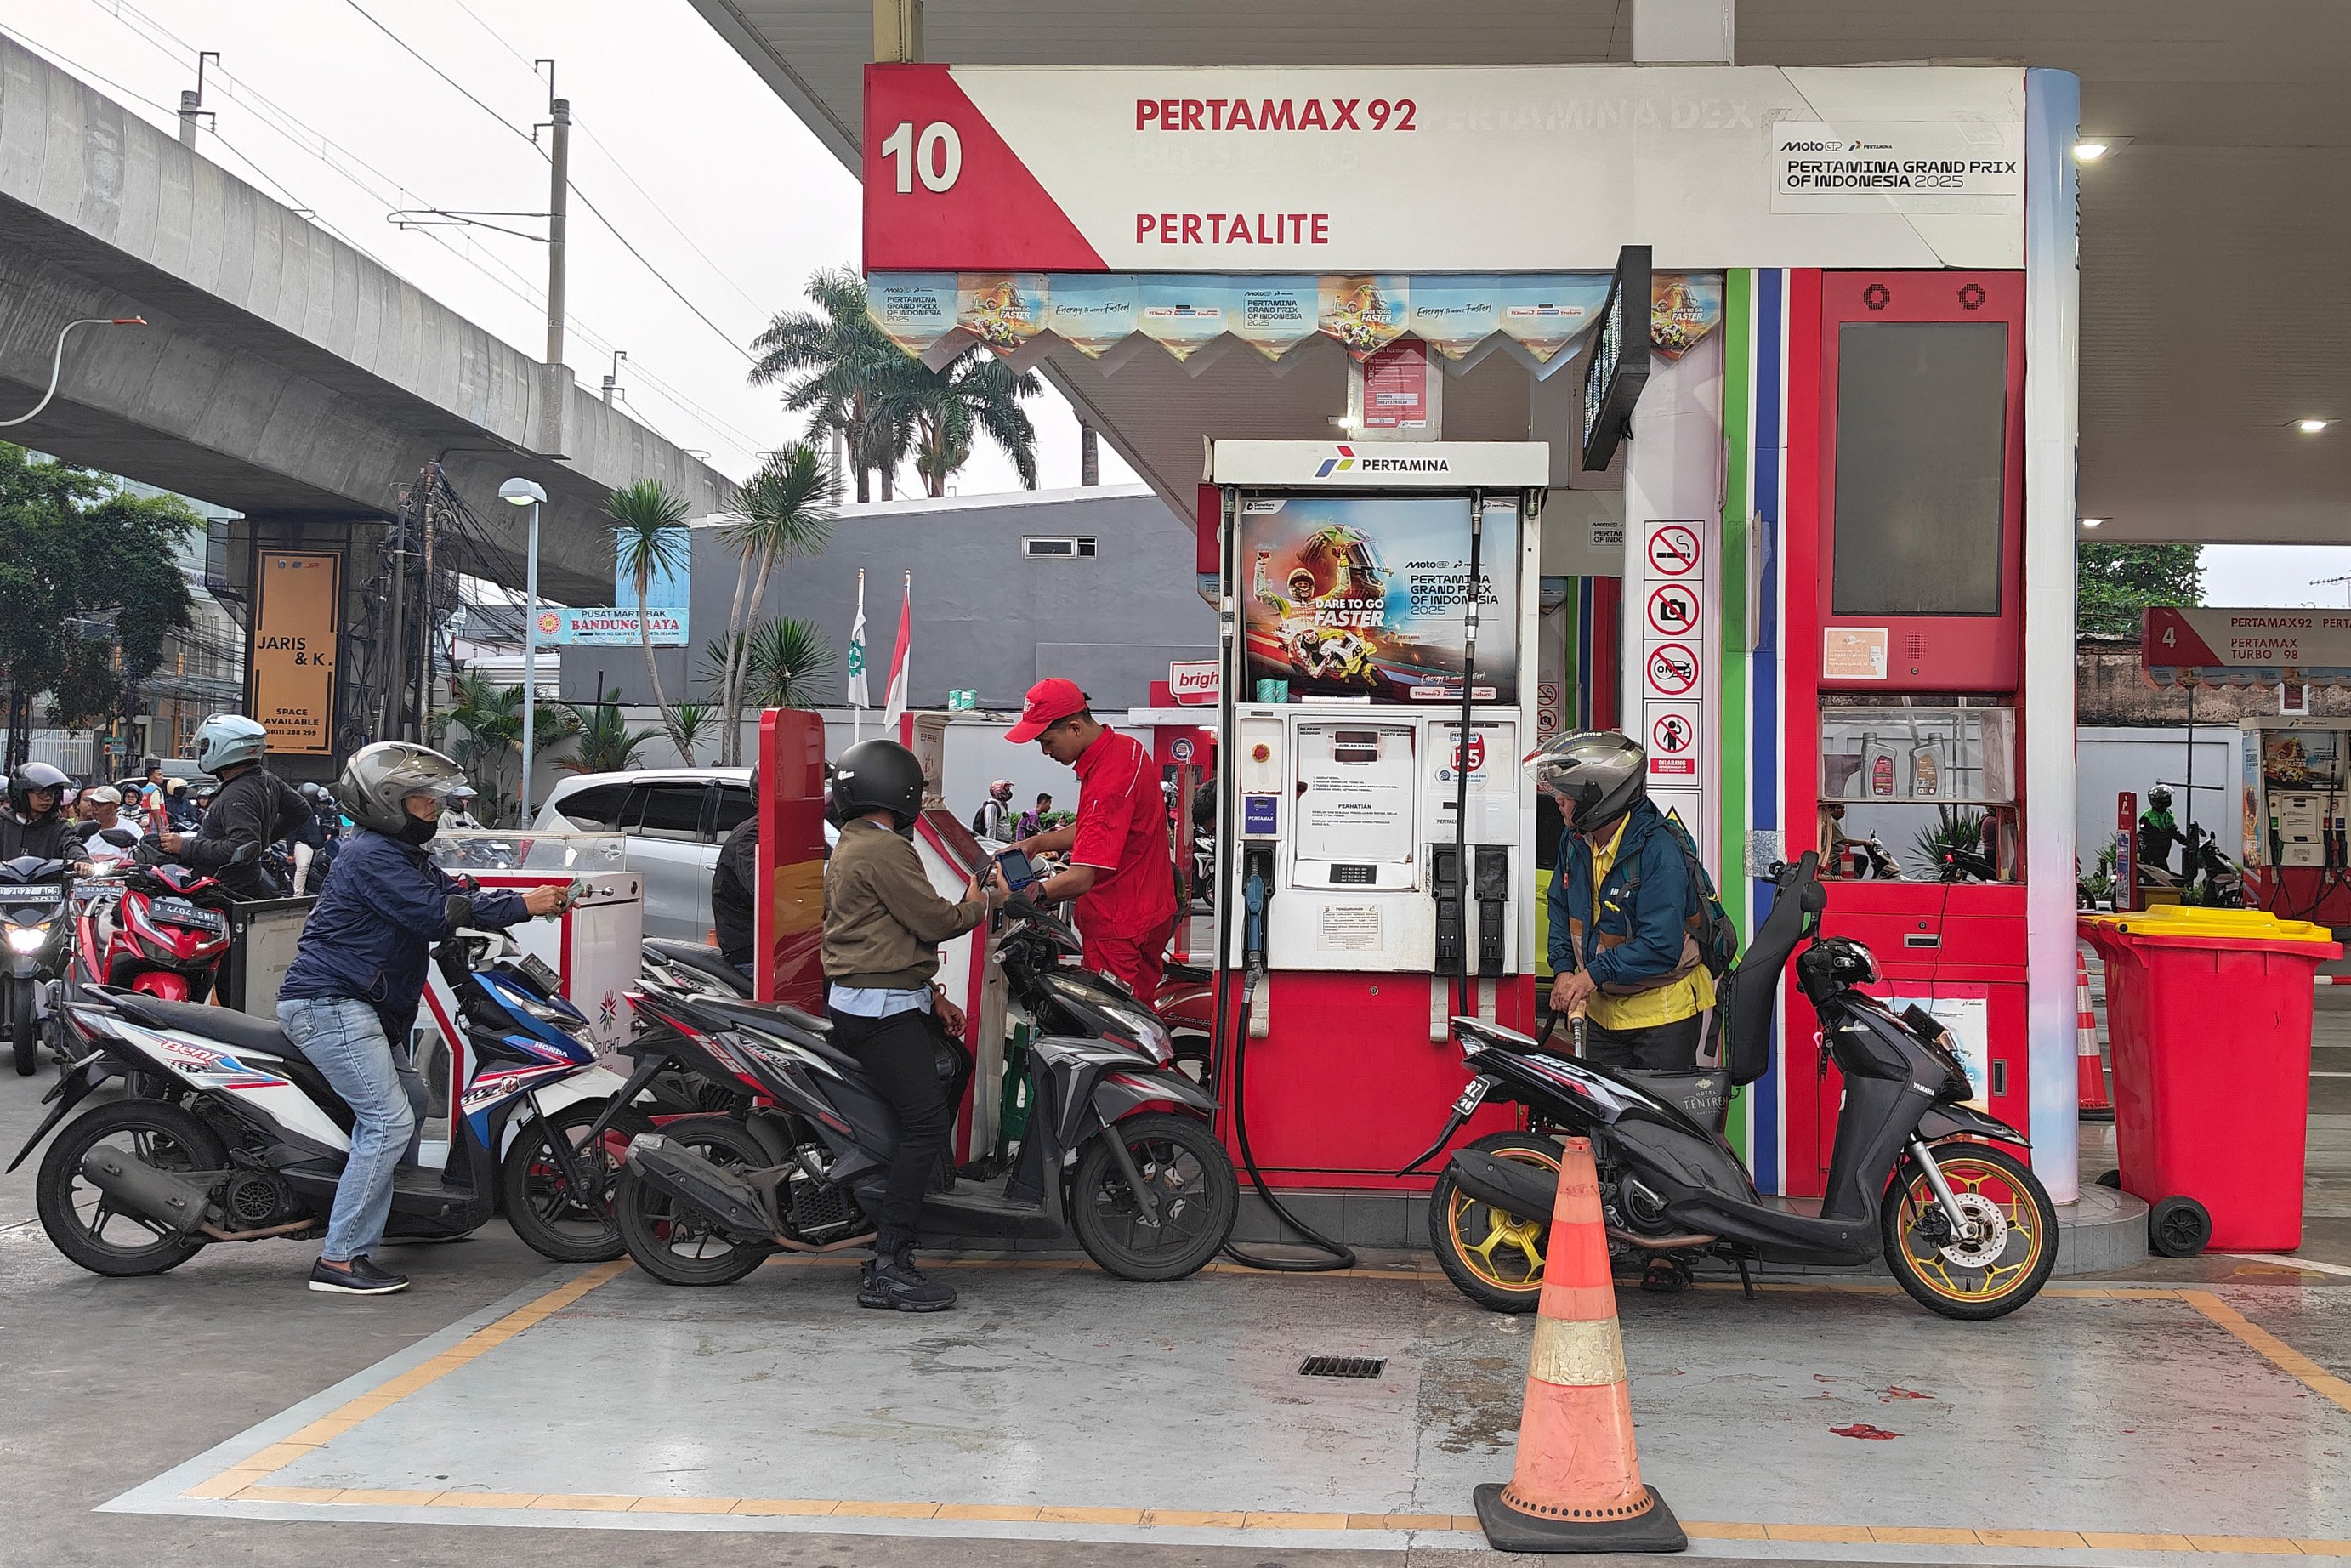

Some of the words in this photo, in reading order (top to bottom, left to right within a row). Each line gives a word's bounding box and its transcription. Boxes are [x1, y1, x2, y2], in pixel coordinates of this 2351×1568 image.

[1136, 99, 1360, 131] PERTAMAX
[1368, 99, 1417, 131] 92
[881, 122, 962, 194] 10
[1787, 160, 1900, 173] PERTAMINA
[1902, 160, 1966, 173] GRAND
[1969, 161, 2017, 173] PRIX
[1787, 175, 1812, 188] OF
[1814, 175, 1911, 188] INDONESIA
[1914, 175, 1964, 188] 2025
[1136, 213, 1329, 244] PERTALITE
[1055, 304, 1082, 315] Energy
[1104, 302, 1131, 314] Faster!
[1417, 305, 1445, 318] Energy
[1465, 303, 1493, 315] Faster!
[1000, 311, 1031, 320] FASTER
[1361, 314, 1392, 322] FASTER
[1672, 312, 1703, 321] FASTER
[1362, 459, 1449, 472] PERTAMINA
[1411, 575, 1491, 584] PERTAMIA
[1411, 585, 1456, 594] GRAND
[1315, 599, 1345, 609] DARE
[1348, 599, 1363, 609] TO
[1366, 599, 1384, 609] GO
[1411, 595, 1428, 605] OF
[1430, 595, 1499, 605] INDONSIA
[1411, 605, 1446, 615] 2025
[571, 619, 638, 630] BANDUNG
[1314, 610, 1385, 627] FASTER
[2230, 617, 2297, 628] PERTAMAX
[2297, 618, 2313, 628] 92
[258, 637, 306, 650] JARIS
[2161, 627, 2177, 648] 4
[2230, 638, 2298, 648] PERTAMAX
[1352, 645, 1364, 659] 49
[2230, 650, 2272, 659] TURBO
[2284, 650, 2298, 659] 98
[294, 652, 307, 666] &
[1657, 665, 1672, 673] ON
[1179, 671, 1219, 688] brigh
[1421, 673, 1444, 684] Energy
[275, 707, 308, 716] SPACE
[167, 905, 191, 916] 4404
[534, 1042, 569, 1058] HONDA
[1913, 1082, 1935, 1097] YAMAHA
